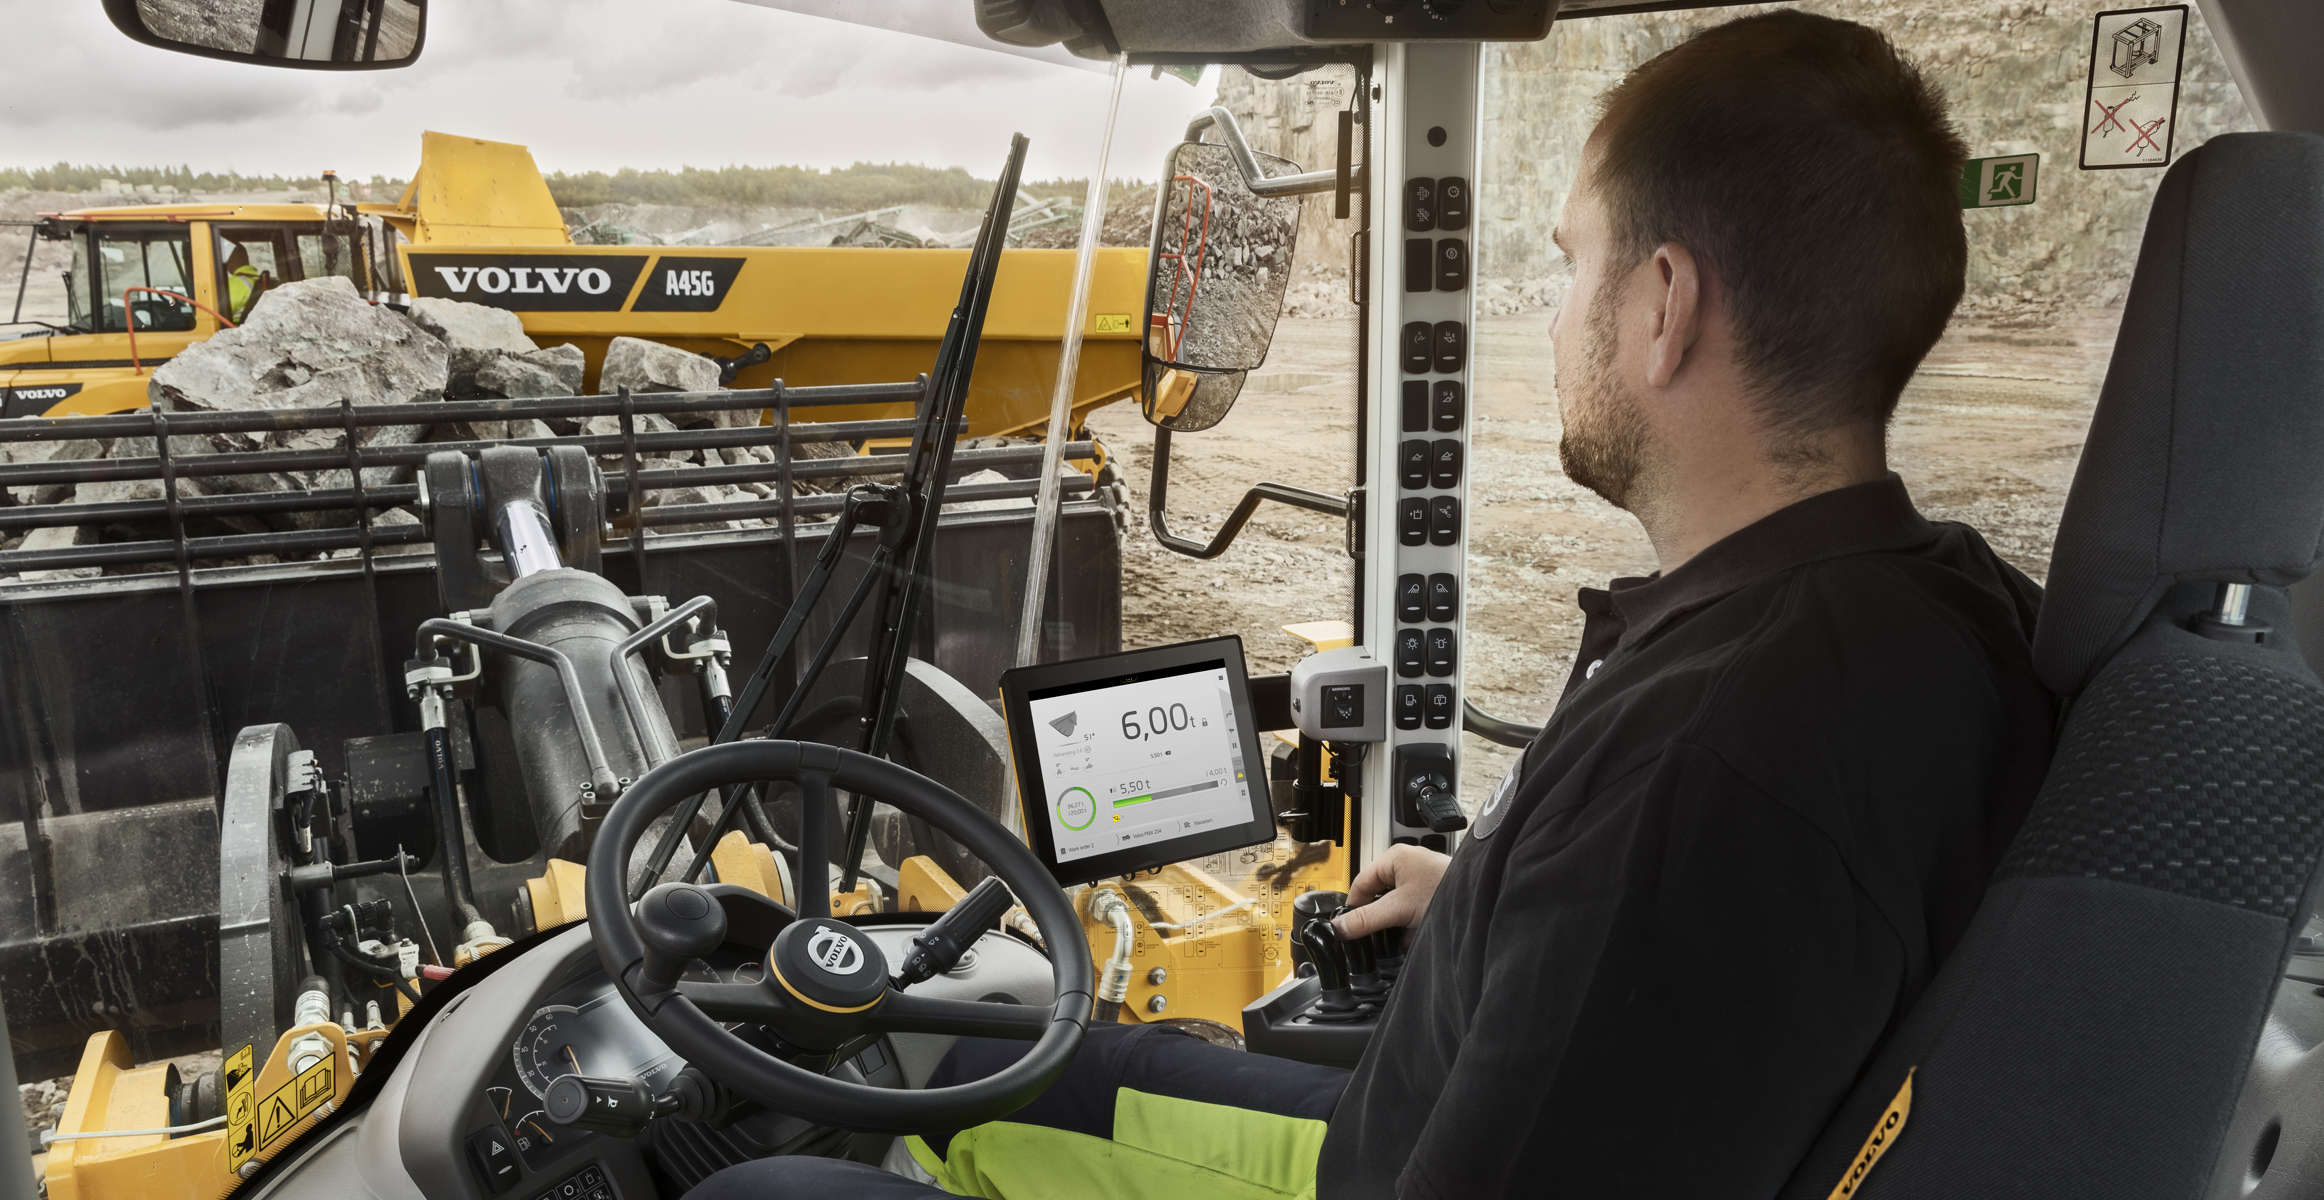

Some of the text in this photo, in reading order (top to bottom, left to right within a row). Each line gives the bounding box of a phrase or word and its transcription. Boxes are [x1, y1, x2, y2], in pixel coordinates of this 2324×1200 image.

[434, 266, 612, 295] VOLVO
[666, 270, 715, 296] A45G
[15, 388, 67, 400] VOLVO
[434, 739, 445, 770] VOLVO
[1119, 779, 1152, 795] 5,50 t
[825, 935, 849, 969] VOLVO
[545, 1013, 553, 1021] 60
[529, 1025, 537, 1033] 50
[639, 1063, 668, 1080] VOLVO
[1841, 1111, 1900, 1195] VOLVO
